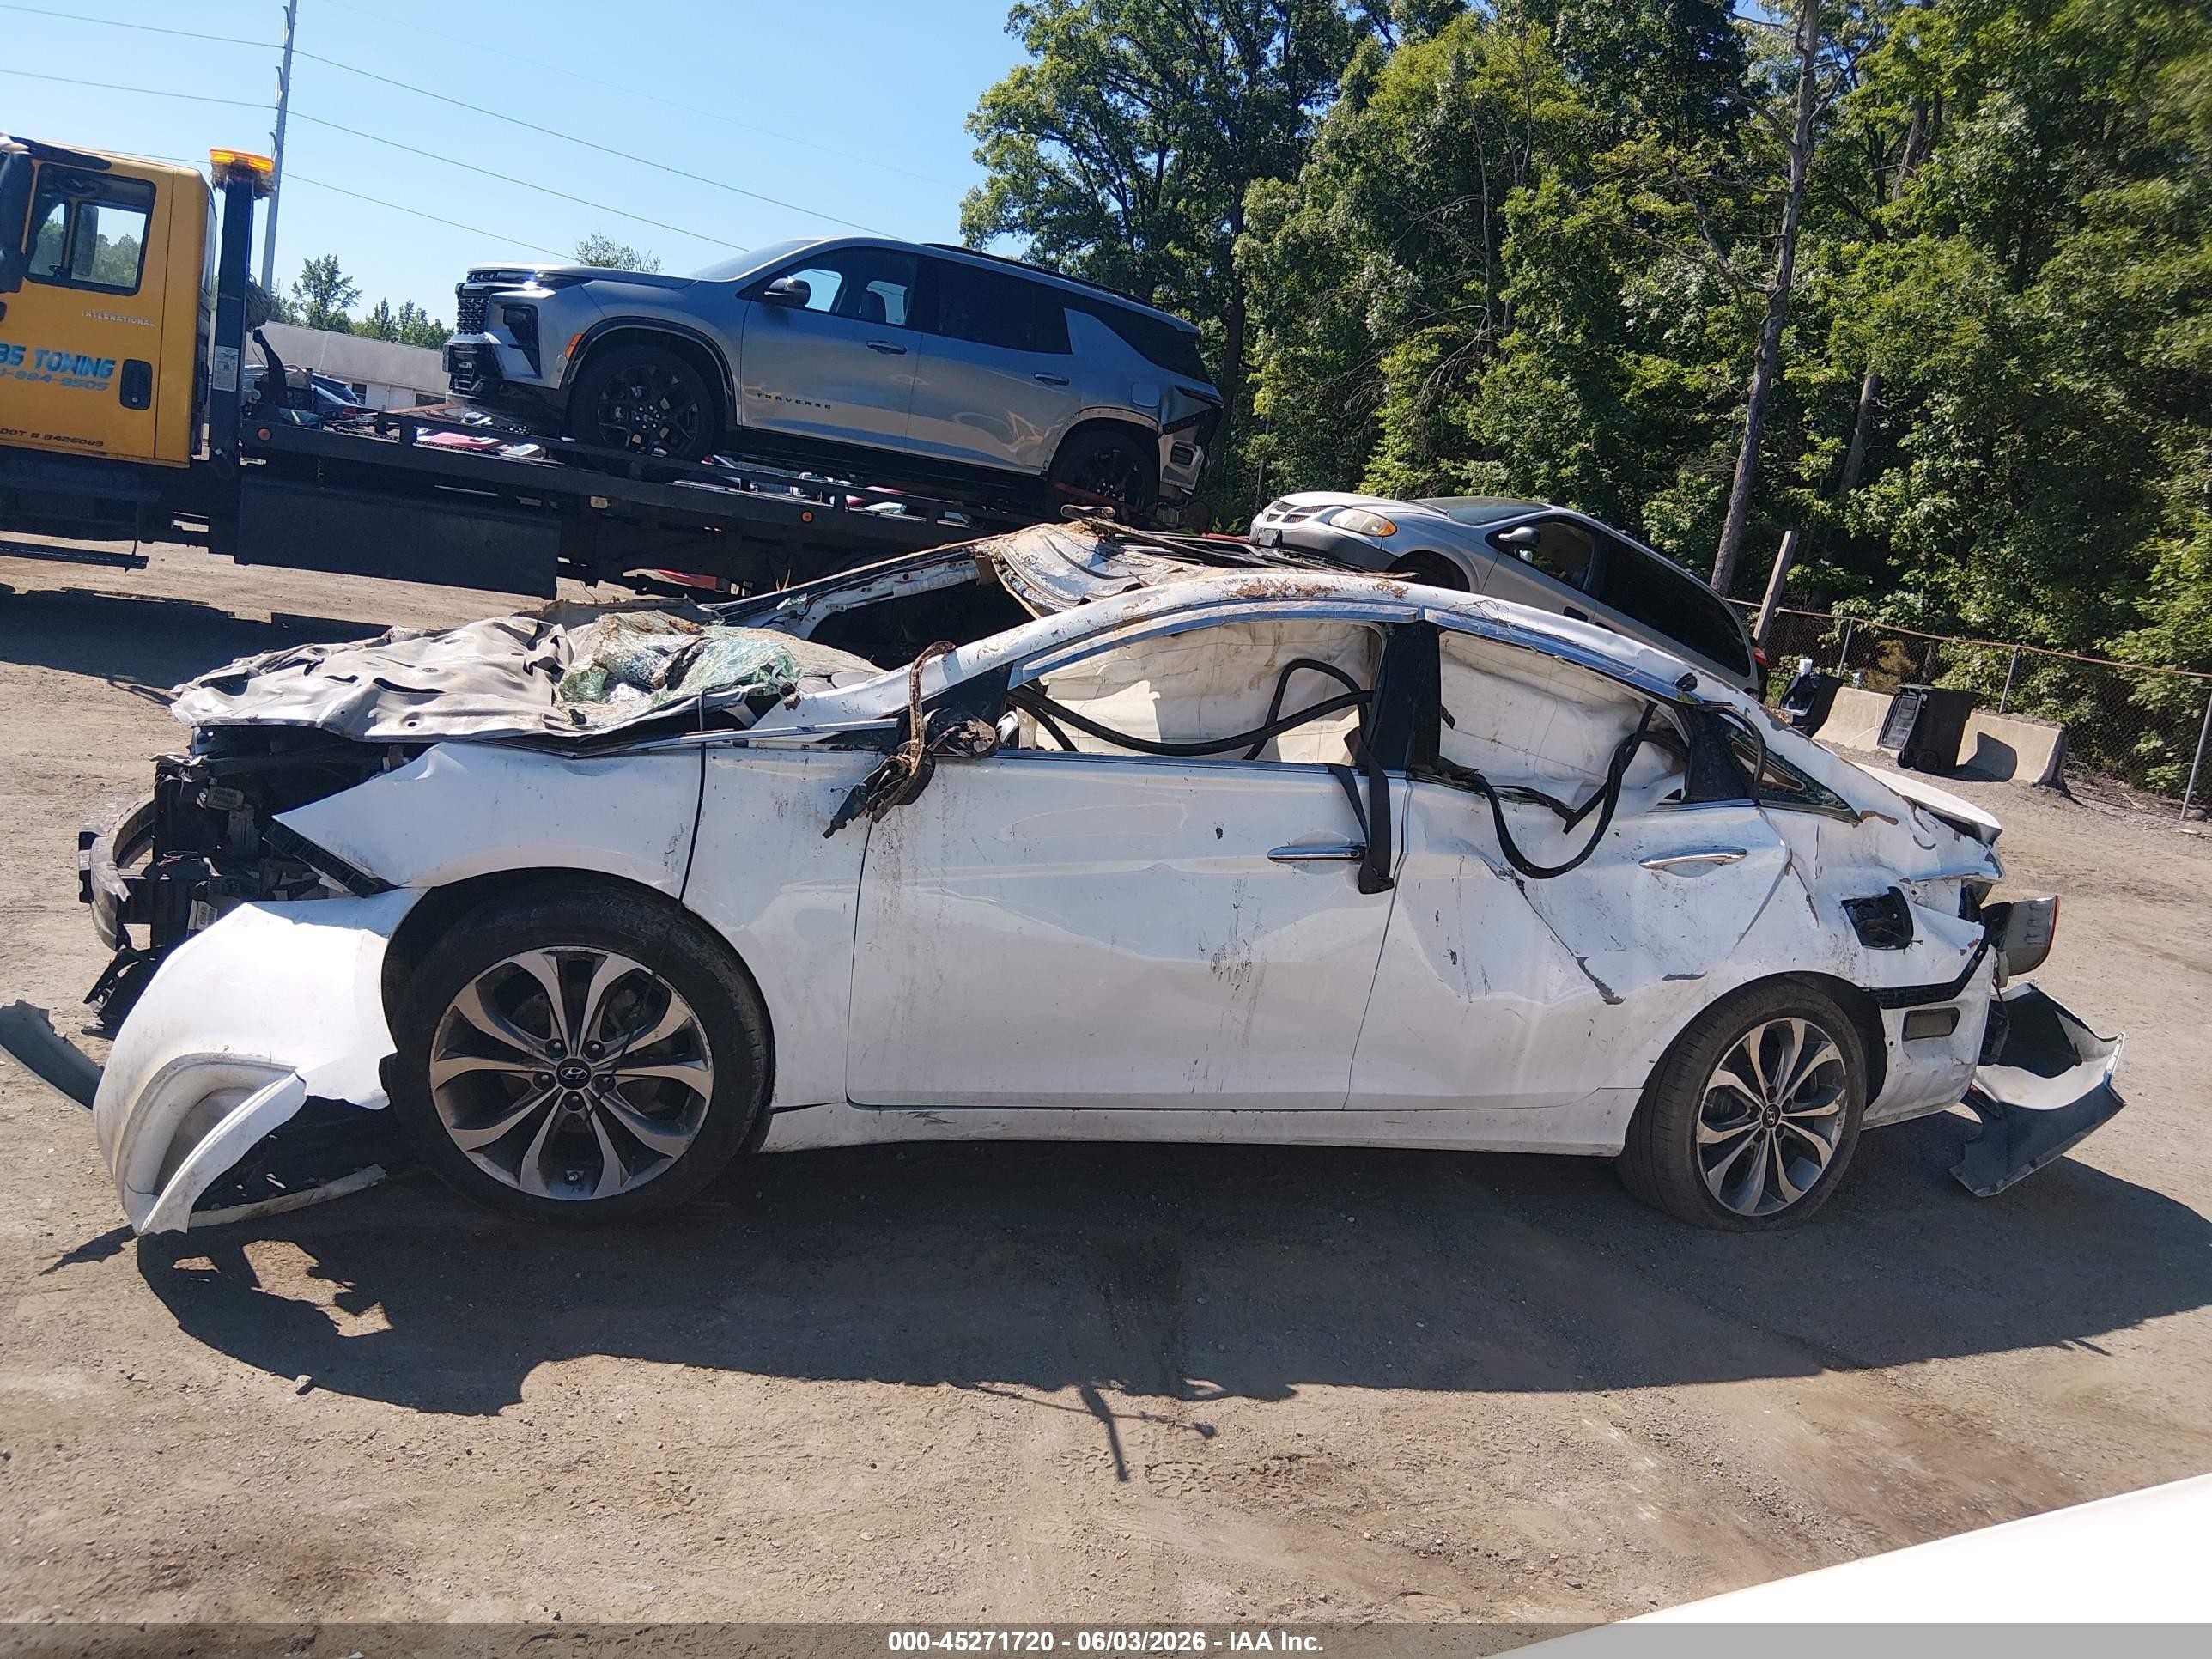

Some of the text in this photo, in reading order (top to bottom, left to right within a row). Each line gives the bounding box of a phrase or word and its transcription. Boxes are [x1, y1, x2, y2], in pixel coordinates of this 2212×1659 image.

[82, 309, 155, 327] INTERNATIONAL
[35, 349, 116, 379] TOWING
[756, 392, 831, 410] TRAVERSE
